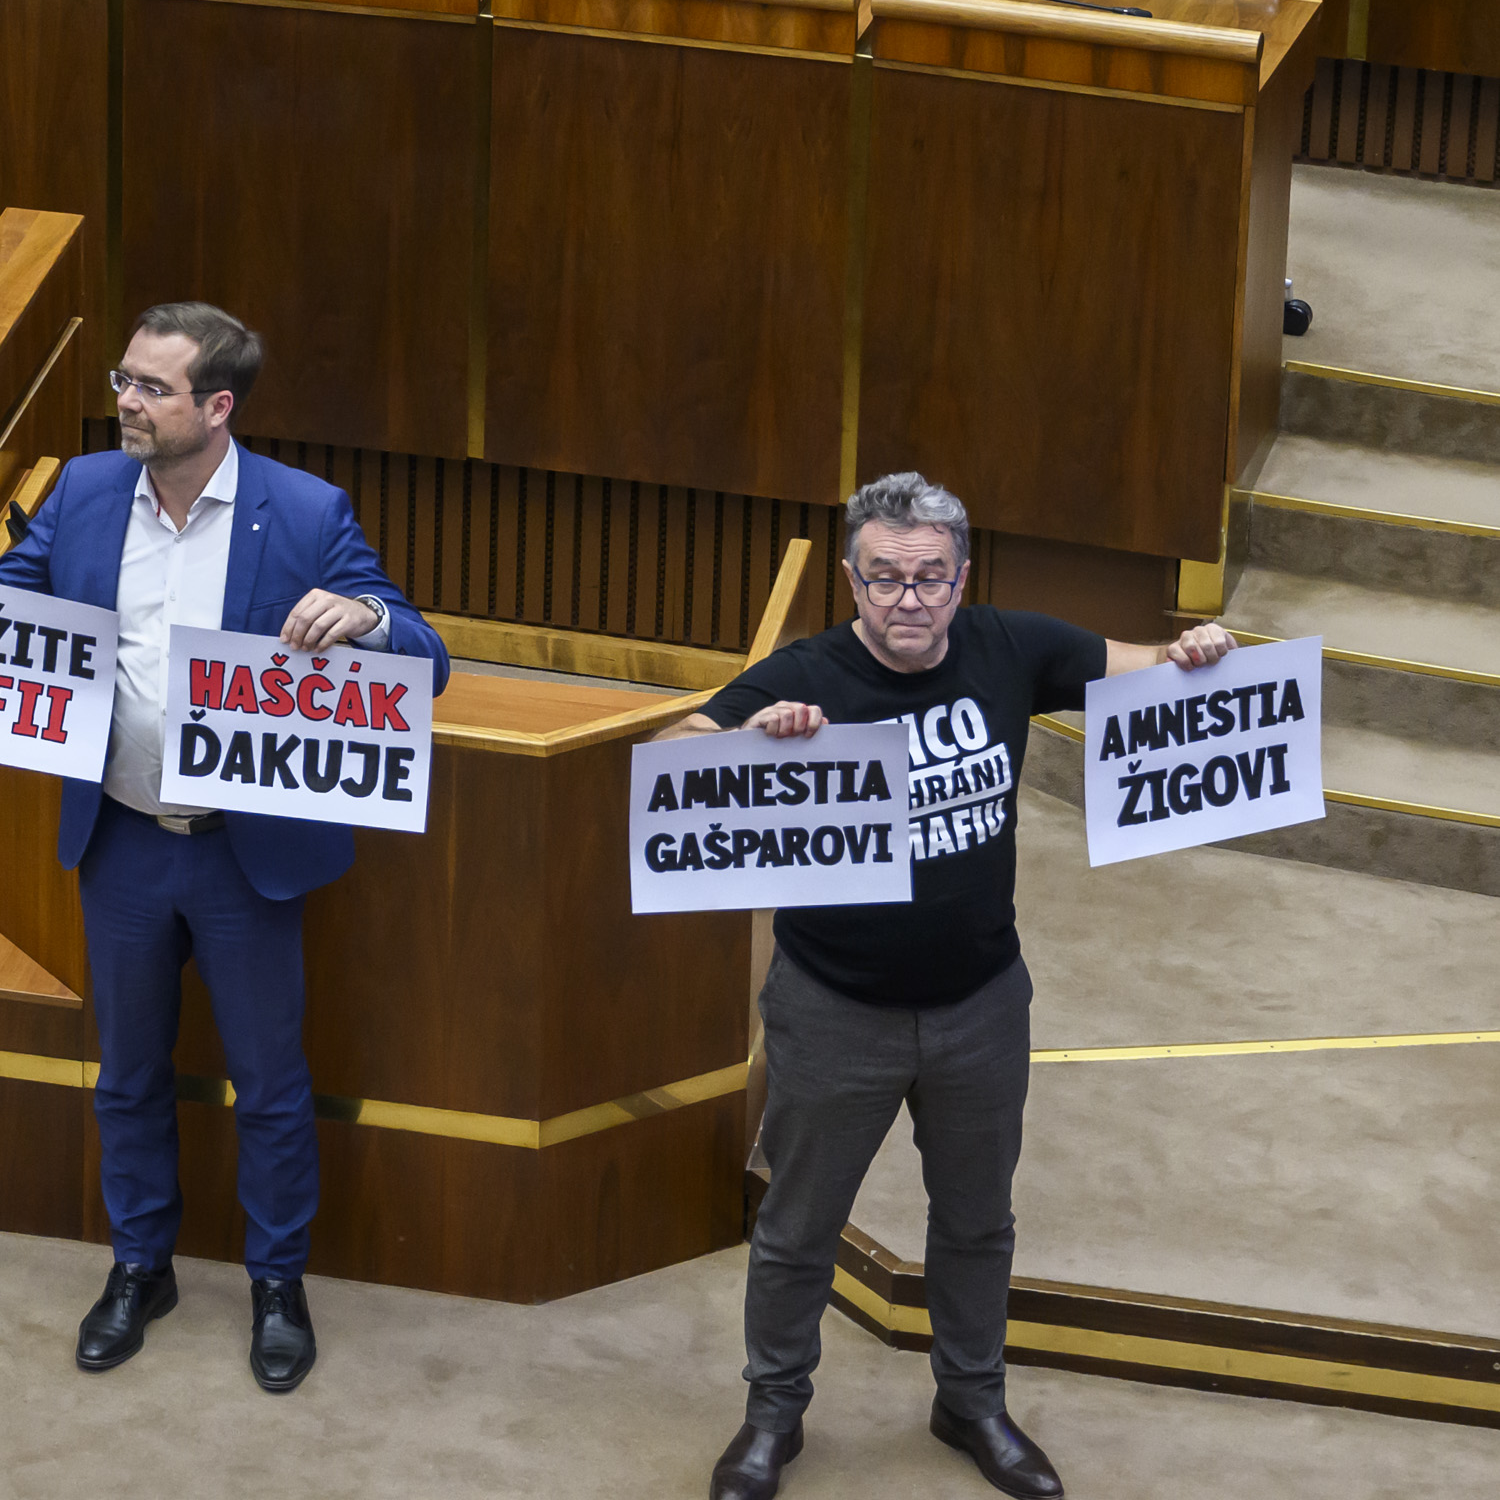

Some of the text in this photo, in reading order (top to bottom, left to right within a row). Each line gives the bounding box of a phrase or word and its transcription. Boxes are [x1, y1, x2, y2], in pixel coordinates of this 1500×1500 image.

[190, 653, 410, 731] HAŠČÁK
[1100, 678, 1304, 761] AMNESTIA
[179, 709, 415, 802] ĎAKUJE
[872, 697, 988, 767] ICO
[647, 760, 892, 812] AMNESTIA
[909, 753, 1005, 810] HRÁNI
[1117, 743, 1290, 828] ŽIGOVI
[645, 822, 892, 872] GAŠPAROVI
